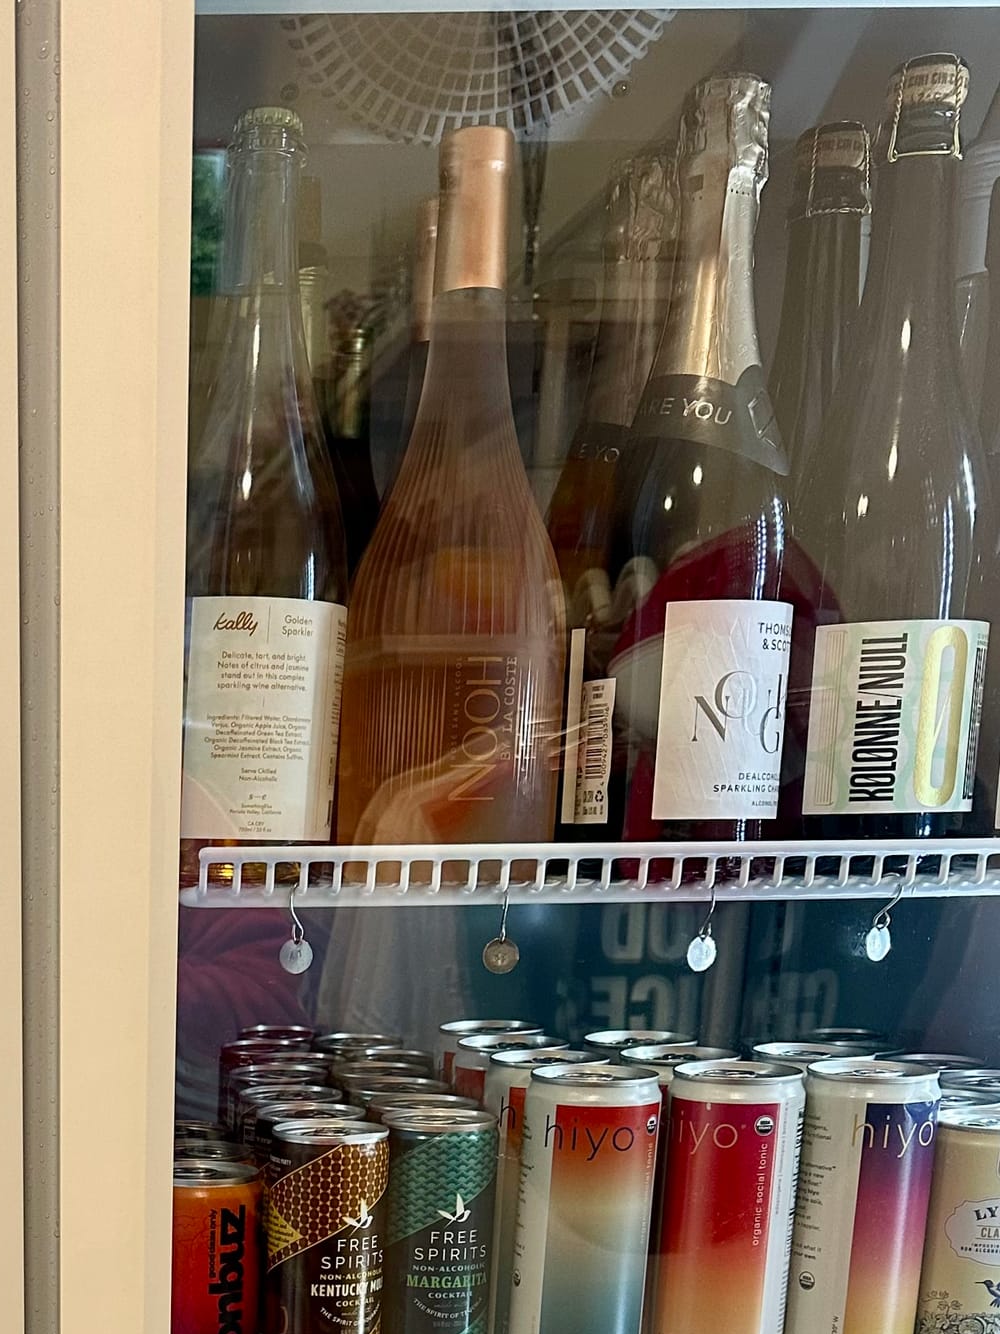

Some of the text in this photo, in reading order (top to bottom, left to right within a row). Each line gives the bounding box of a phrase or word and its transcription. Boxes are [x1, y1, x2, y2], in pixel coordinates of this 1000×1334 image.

[682, 398, 732, 425] YOU
[213, 611, 258, 636] kally
[284, 614, 313, 626] Golden
[282, 626, 314, 638] Sparkler
[221, 651, 285, 661] Delicate, and
[217, 661, 284, 671] Notes of citrus and
[217, 681, 250, 691] sparkling
[500, 656, 518, 761] BY LA COSTE
[448, 656, 503, 801] NOOH
[713, 784, 766, 793] SPARKLING
[544, 1114, 635, 1161] hiyo
[851, 1112, 935, 1158] hiyo
[752, 1141, 769, 1247] organic social tonic
[337, 1235, 379, 1252] FREE
[430, 1229, 479, 1245] FREE
[320, 1249, 383, 1269] SPIRITS
[413, 1244, 487, 1261] SPIRITS
[412, 1262, 486, 1273] NON-ALCOHOLIC
[406, 1272, 488, 1289] MARGARITA
